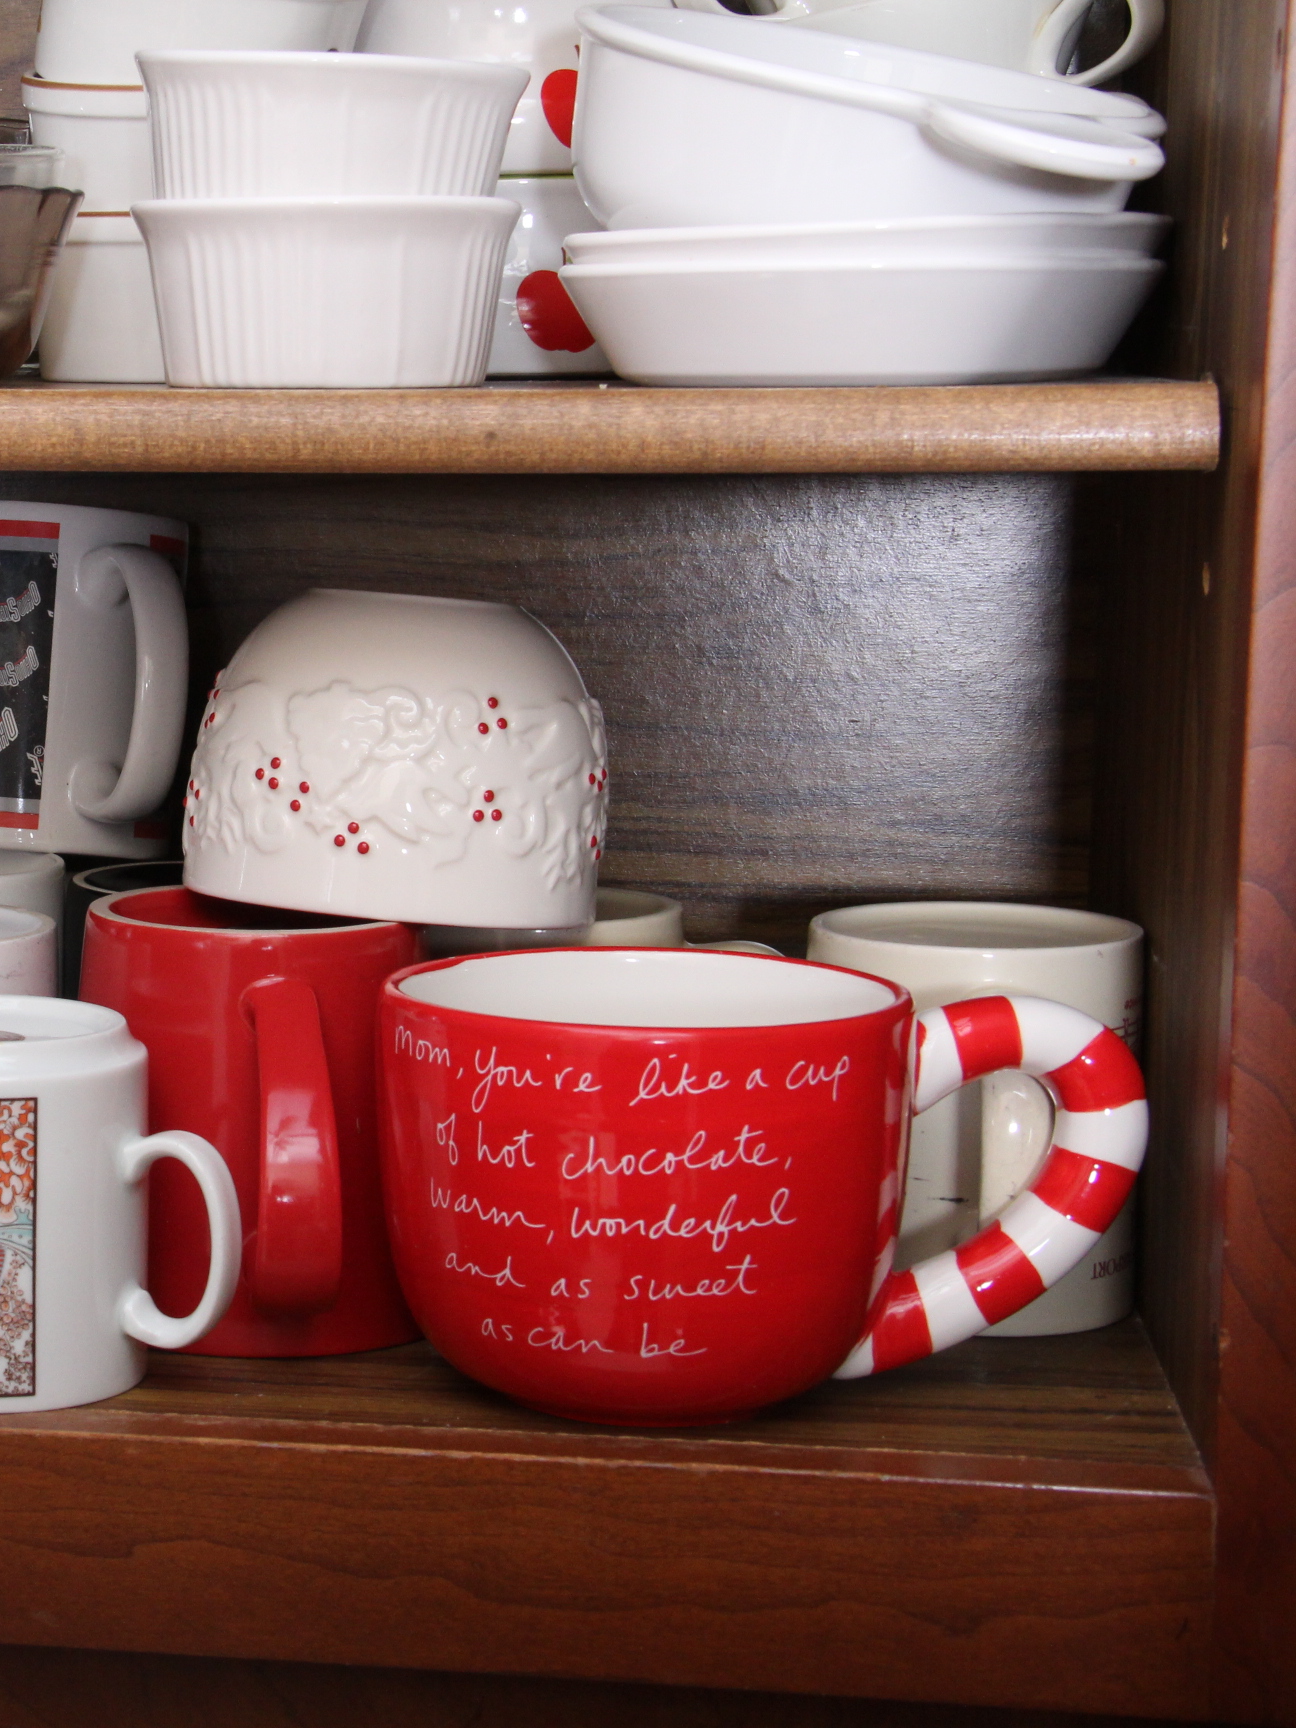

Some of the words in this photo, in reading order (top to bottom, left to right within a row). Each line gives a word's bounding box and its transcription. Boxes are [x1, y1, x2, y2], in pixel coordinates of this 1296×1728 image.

[629, 1052, 729, 1106] like
[745, 1067, 768, 1091] a
[436, 1112, 458, 1166] of
[477, 1120, 535, 1168] hot
[445, 1252, 526, 1288] and
[551, 1278, 590, 1299] as
[624, 1255, 757, 1298] sweet
[481, 1317, 514, 1343] as
[527, 1325, 613, 1354] can
[640, 1323, 708, 1359] be
